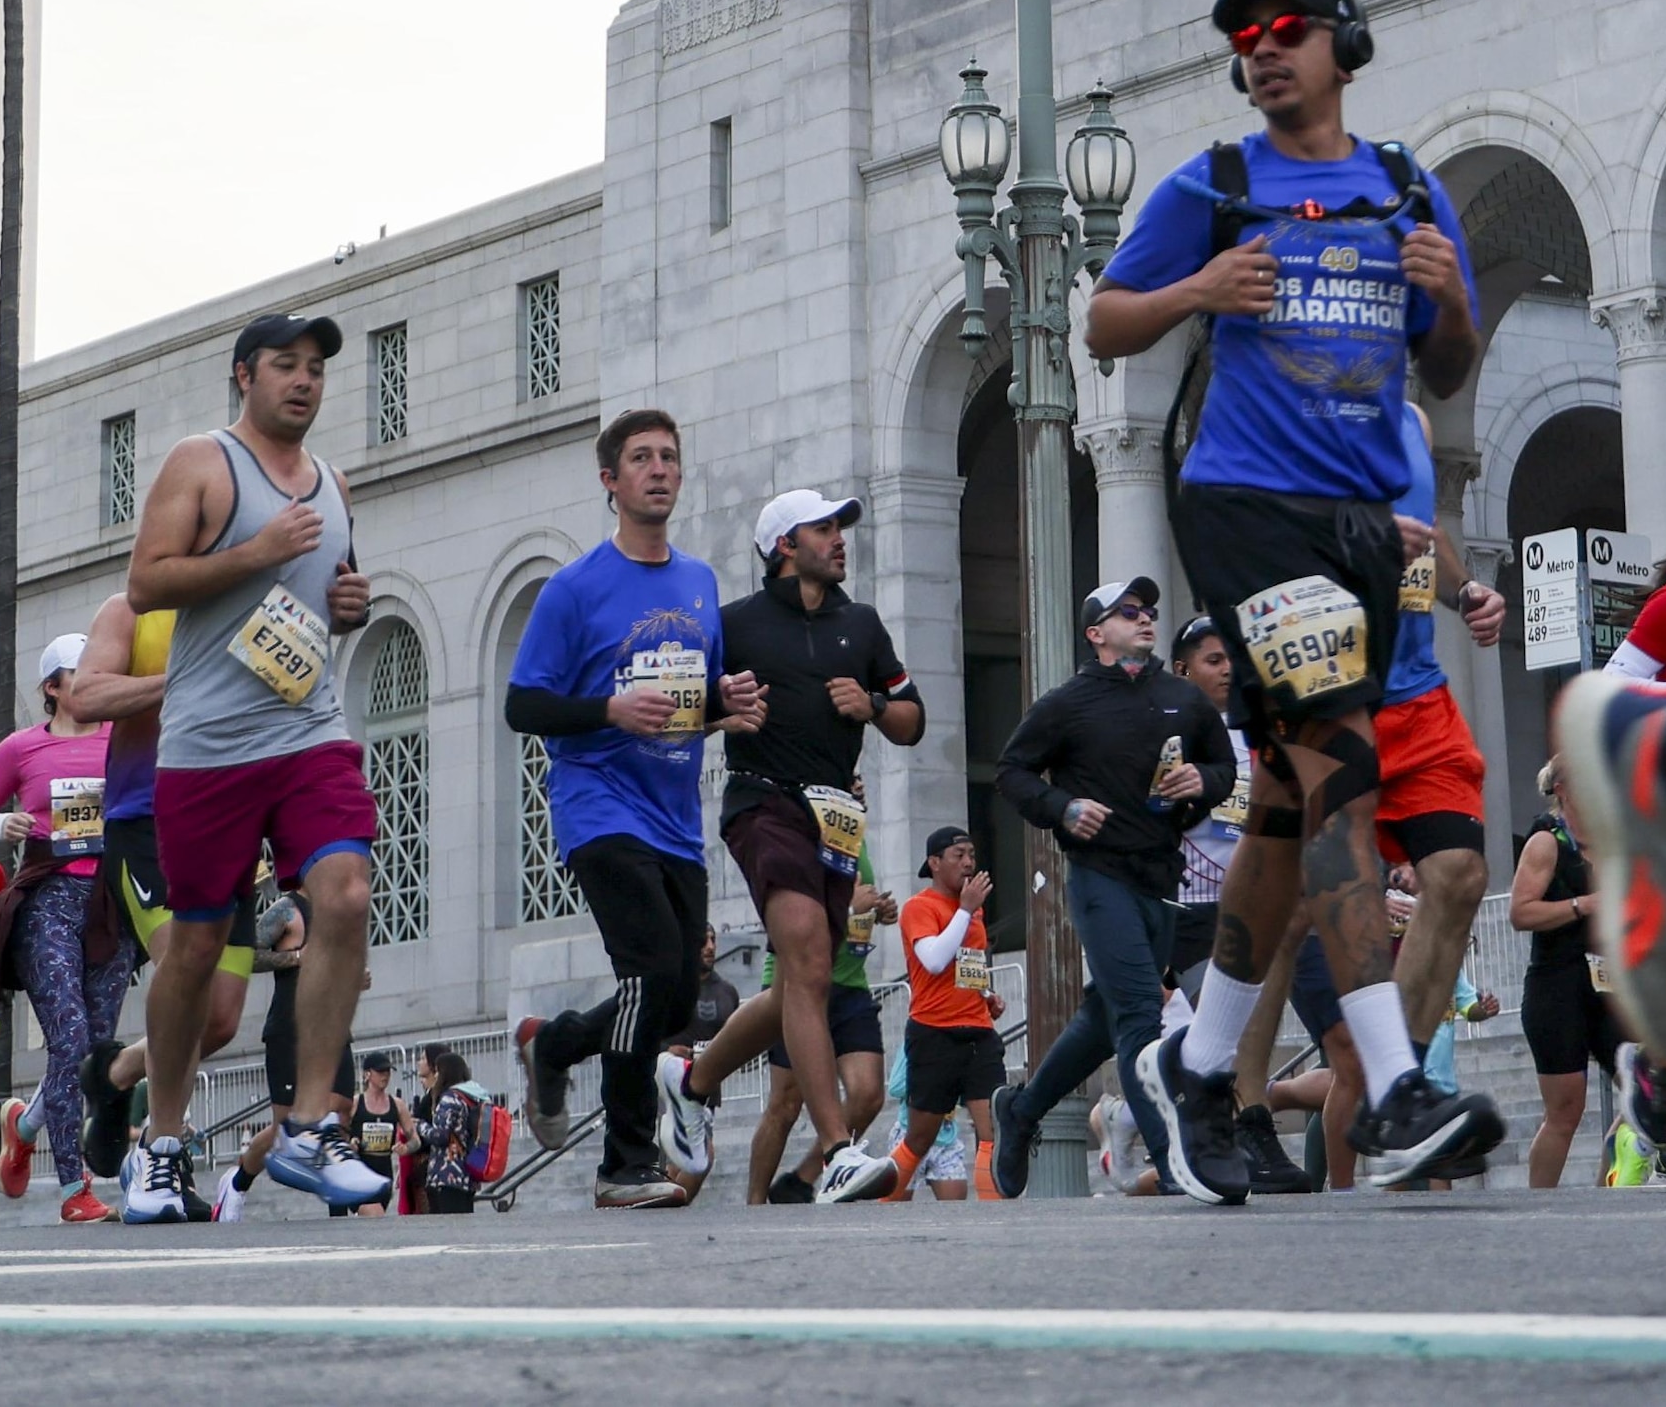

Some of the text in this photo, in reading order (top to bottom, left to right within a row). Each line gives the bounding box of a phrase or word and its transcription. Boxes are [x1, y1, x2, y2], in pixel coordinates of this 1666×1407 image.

[1318, 246, 1359, 271] 40
[1274, 277, 1303, 297] OS
[1259, 299, 1406, 330] MARATHON
[1547, 560, 1574, 574] Metro
[1616, 561, 1649, 577] Metro
[1526, 588, 1540, 604] 70
[1527, 606, 1546, 622] 487
[1528, 625, 1547, 642] 489
[252, 625, 313, 681] E7297
[1264, 625, 1356, 679] 26904
[615, 668, 633, 680] LO
[667, 690, 702, 709] 62
